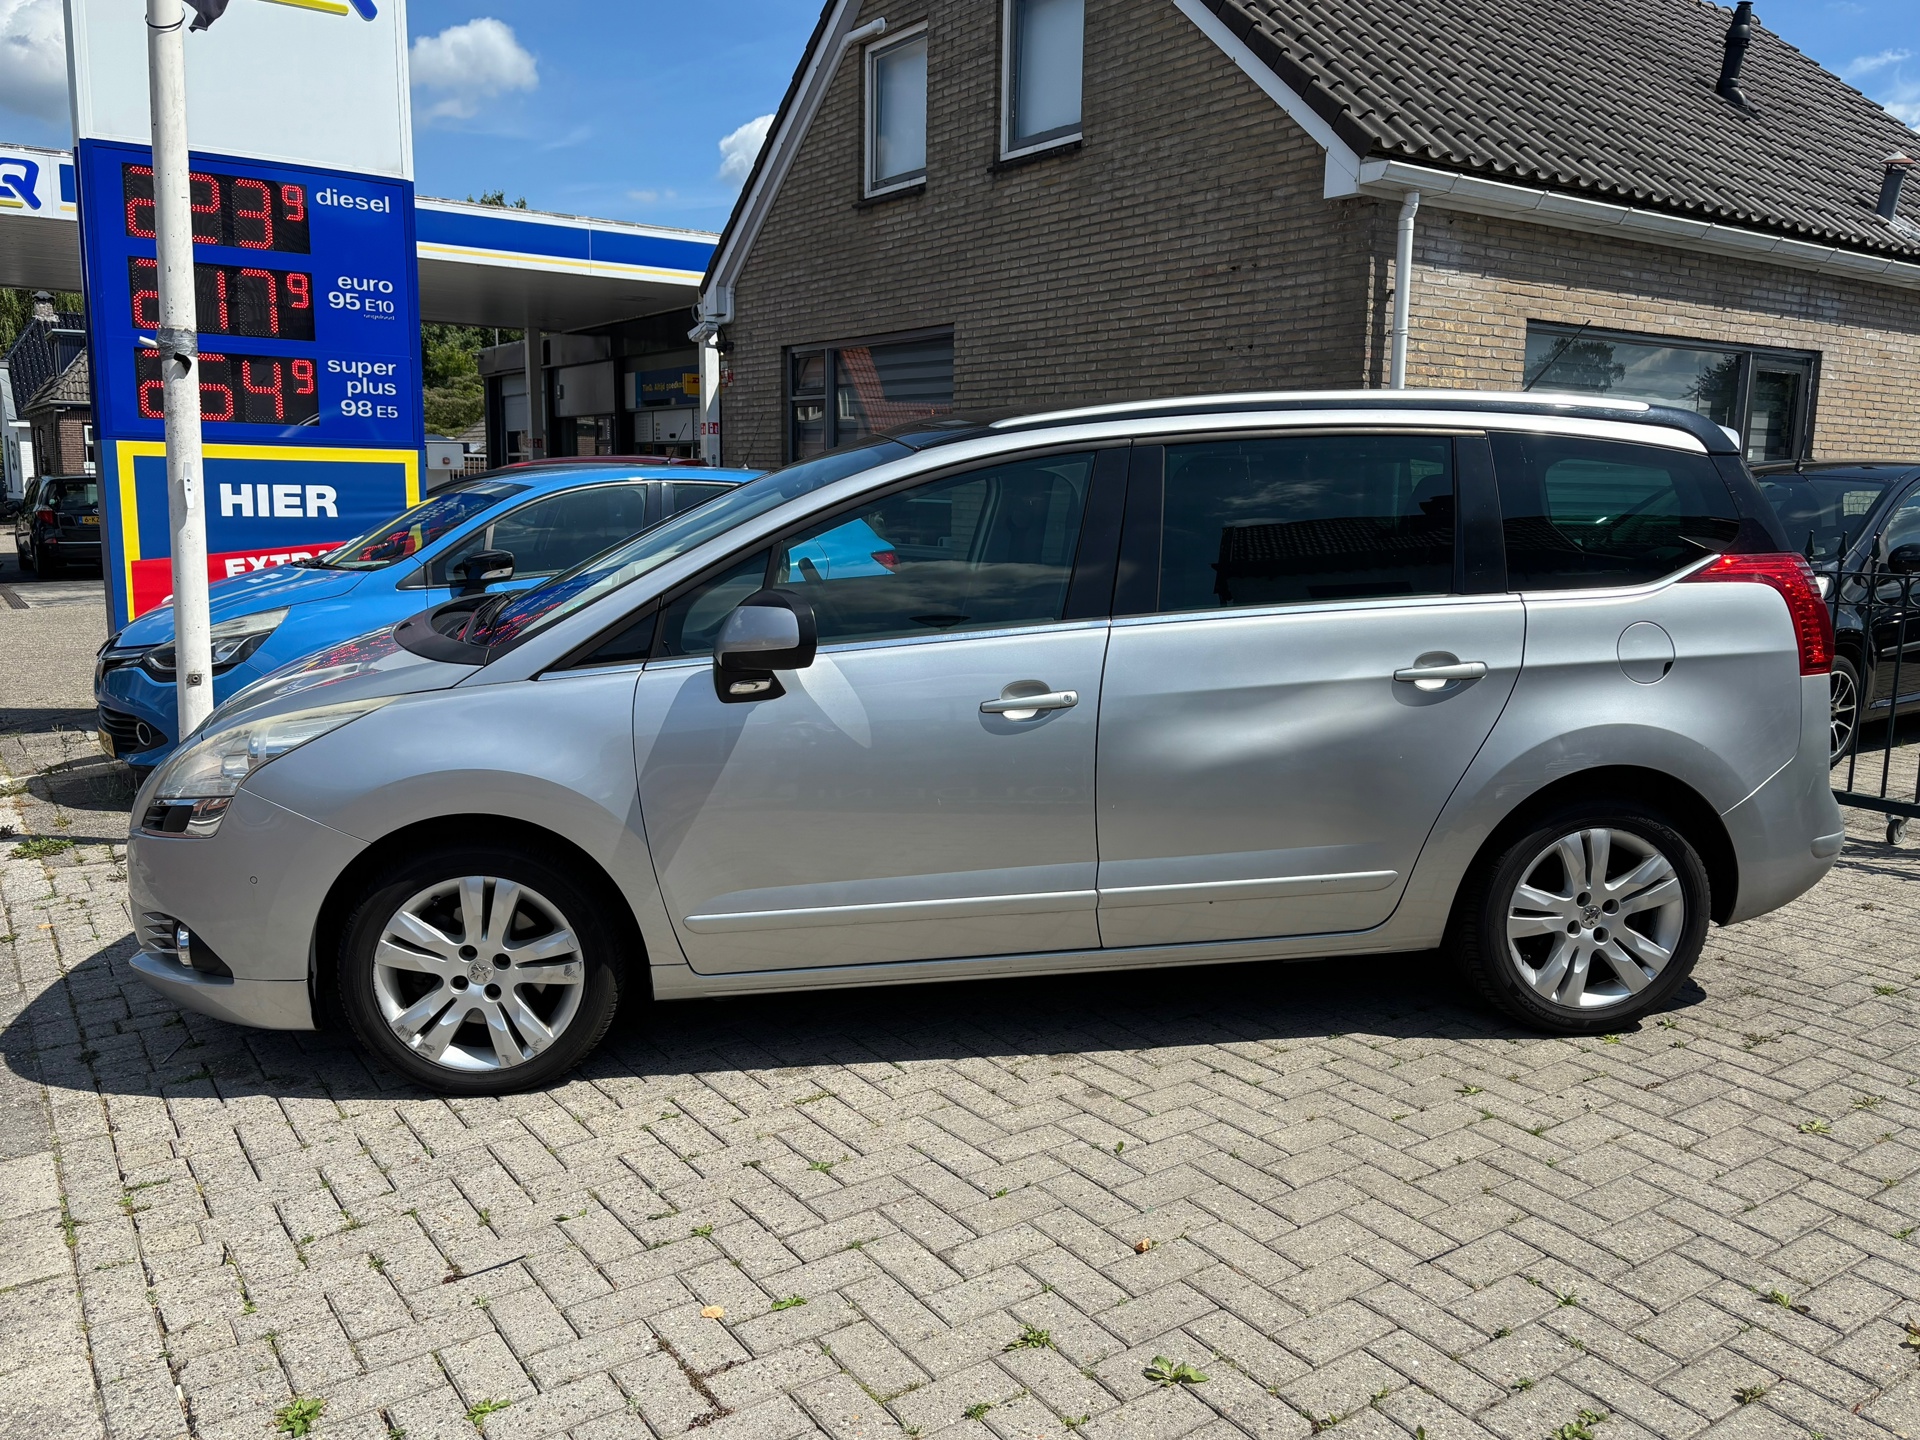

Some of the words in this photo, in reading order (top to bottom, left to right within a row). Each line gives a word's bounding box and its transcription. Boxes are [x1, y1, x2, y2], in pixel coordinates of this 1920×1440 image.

[315, 188, 390, 213] diesel
[337, 276, 394, 294] euro
[328, 291, 361, 310] 95
[365, 298, 394, 314] E10
[327, 359, 397, 378] super
[347, 377, 397, 397] plus
[340, 399, 373, 418] 98
[376, 405, 398, 418] E5
[219, 483, 339, 518] HIER
[224, 549, 328, 578] EXTR
